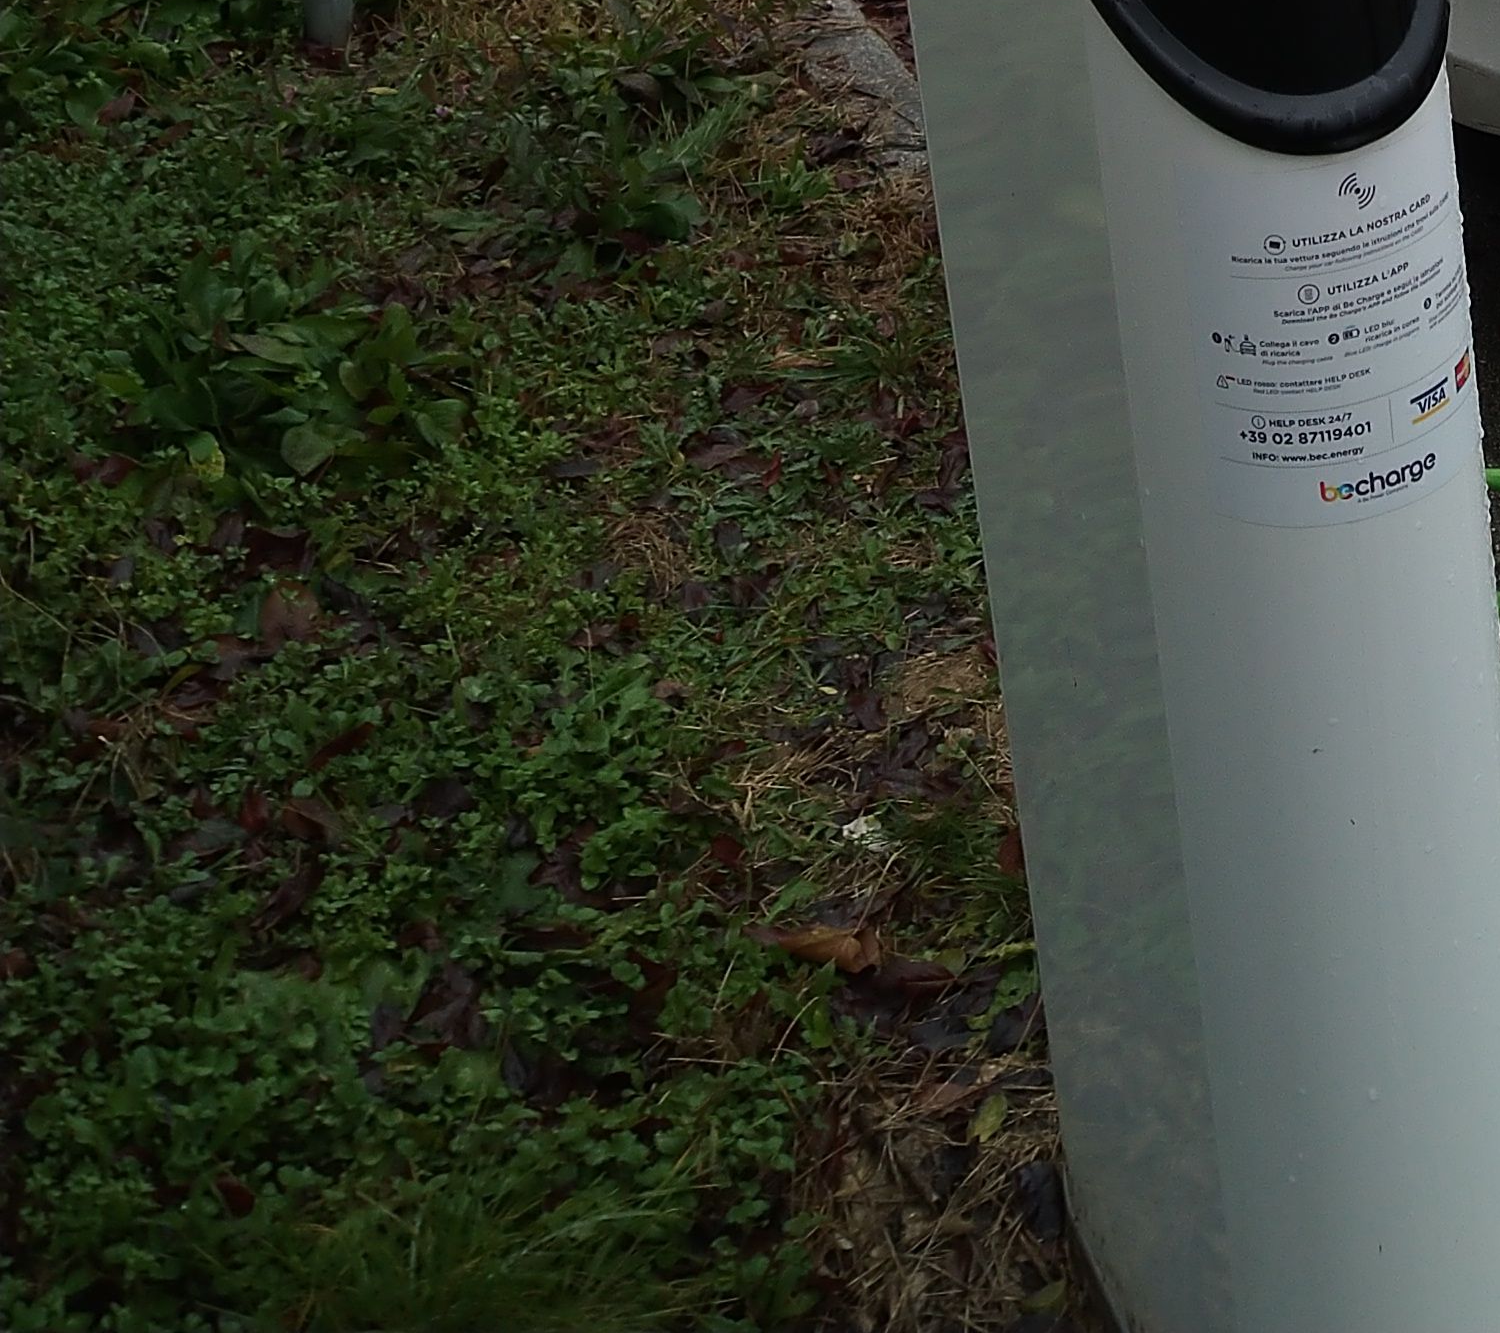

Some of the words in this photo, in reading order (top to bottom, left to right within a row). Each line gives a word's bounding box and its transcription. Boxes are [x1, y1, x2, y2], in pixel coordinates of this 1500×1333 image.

[1291, 231, 1346, 249] UTILIZZA
[1349, 223, 1364, 237] LA
[1366, 209, 1408, 232] NOSTRA
[1408, 193, 1431, 214] CARD
[1231, 254, 1262, 265] Ricarica
[1273, 255, 1287, 265] tua
[1289, 252, 1320, 264] vettura
[1321, 244, 1361, 260] seguendo
[1327, 274, 1379, 296] UTILIZZA
[1381, 261, 1409, 280] L'APP
[1273, 309, 1306, 319] Scarica
[1342, 300, 1354, 310] Be
[1356, 290, 1385, 307] Charge
[1364, 323, 1380, 334] LED
[1364, 329, 1394, 344] ricarica
[1259, 339, 1289, 350] Collega
[1299, 339, 1320, 347] cavo
[1260, 349, 1270, 358] di
[1270, 349, 1301, 358] ricarica
[1236, 377, 1252, 387] LED
[1279, 377, 1323, 389] contattare
[1324, 373, 1347, 386] HELP
[1348, 367, 1371, 381] DESK
[1416, 386, 1447, 415] VISA
[1268, 418, 1296, 429] HELP
[1297, 416, 1326, 428] DESK
[1327, 412, 1353, 424] 24/7
[1239, 429, 1268, 445] +39
[1271, 432, 1294, 446] 02
[1298, 421, 1373, 446] 87119401
[1252, 452, 1280, 463] INFO:
[1281, 444, 1365, 464] www.bec.energy
[1319, 451, 1437, 503] becharge
